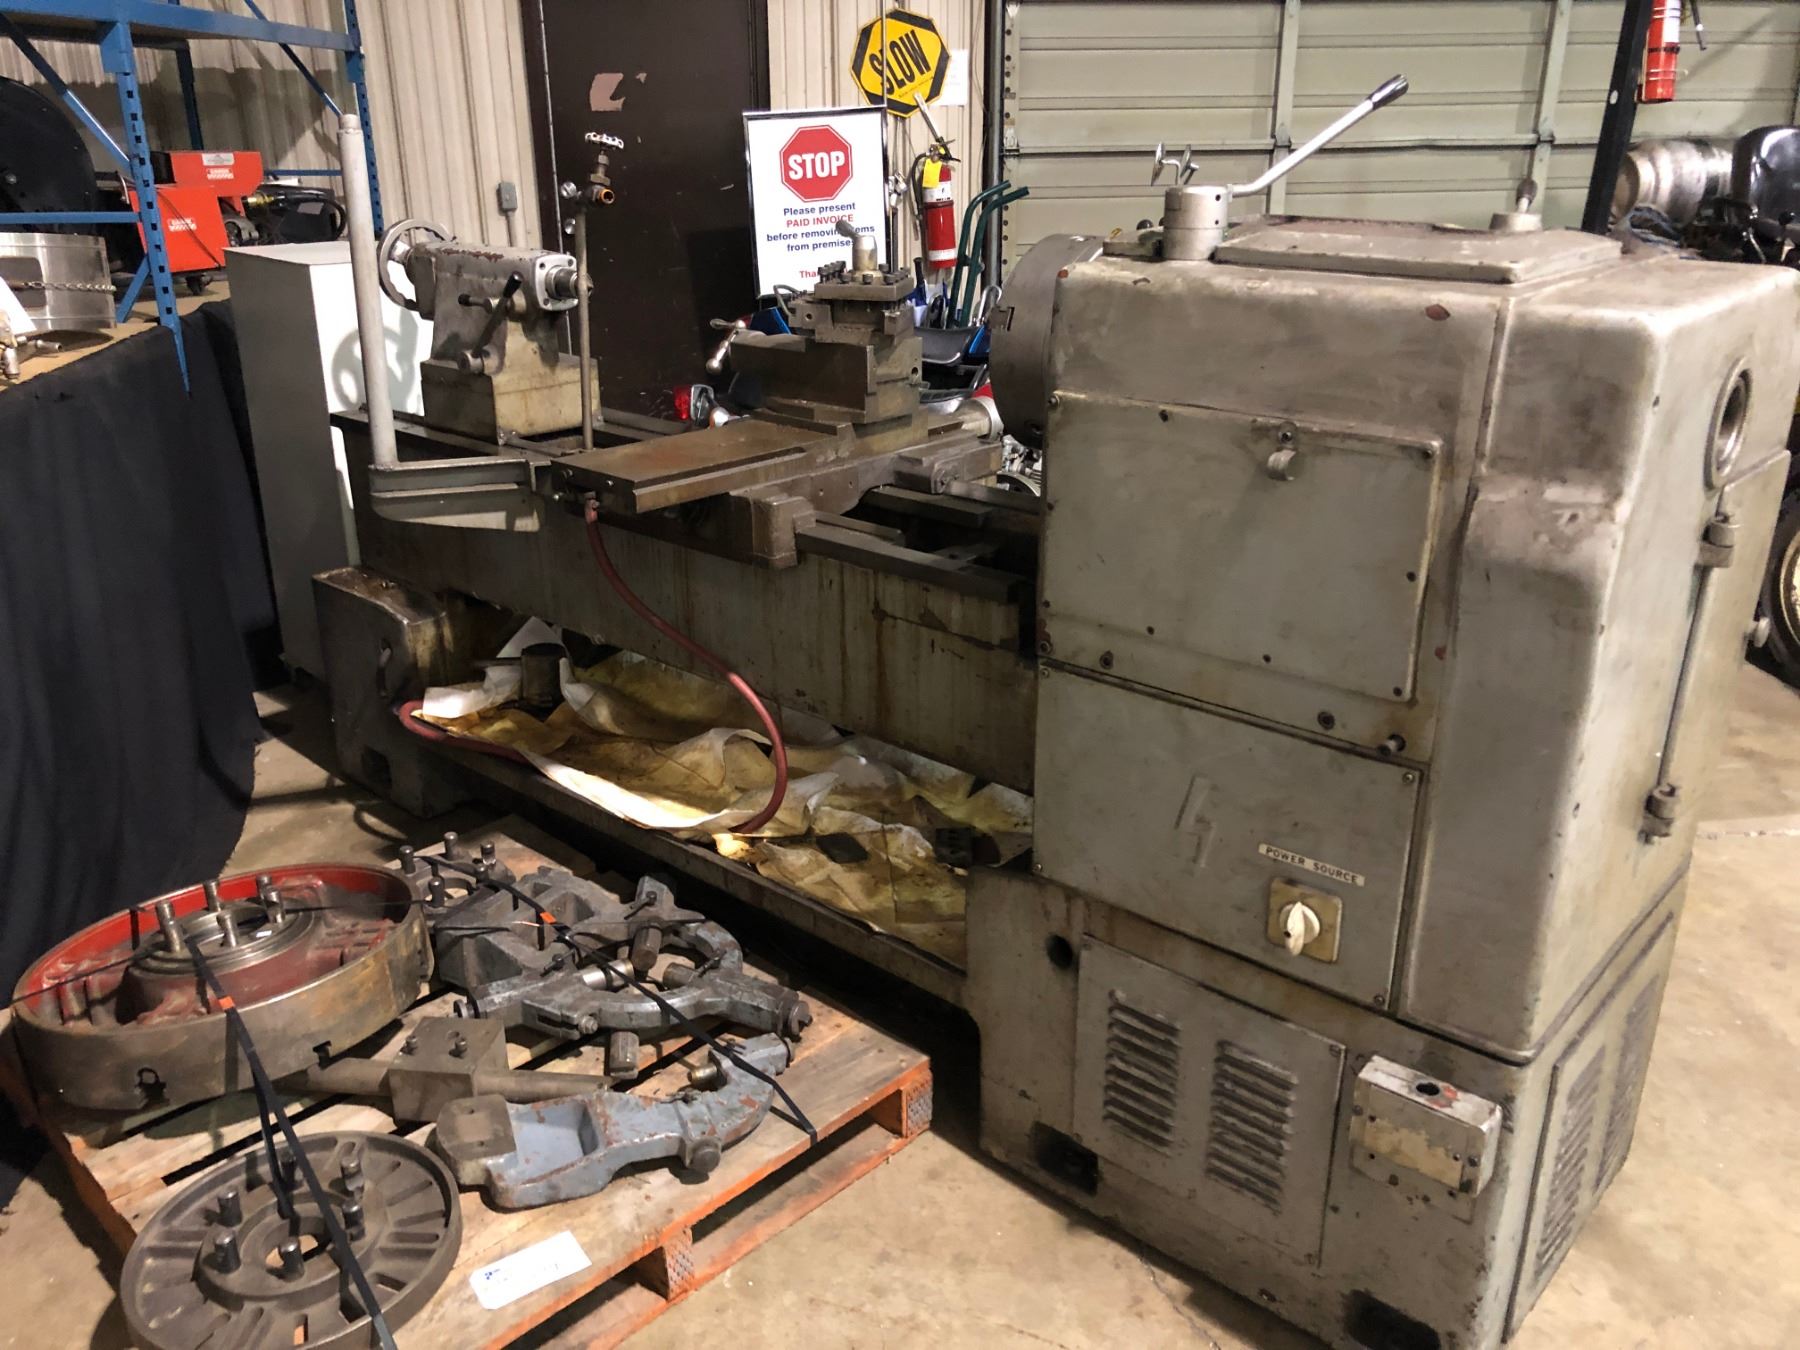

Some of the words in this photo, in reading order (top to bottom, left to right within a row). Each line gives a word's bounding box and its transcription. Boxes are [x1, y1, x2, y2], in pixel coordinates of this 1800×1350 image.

[869, 29, 931, 95] SLOW
[788, 150, 845, 181] STOP
[783, 207, 816, 216] Please
[818, 202, 856, 214] present
[786, 218, 810, 228] PAID
[766, 232, 798, 242] before
[801, 227, 843, 239] removin
[787, 243, 809, 252] from
[1265, 846, 1305, 865] POWER
[1312, 862, 1359, 883] SOURCE
